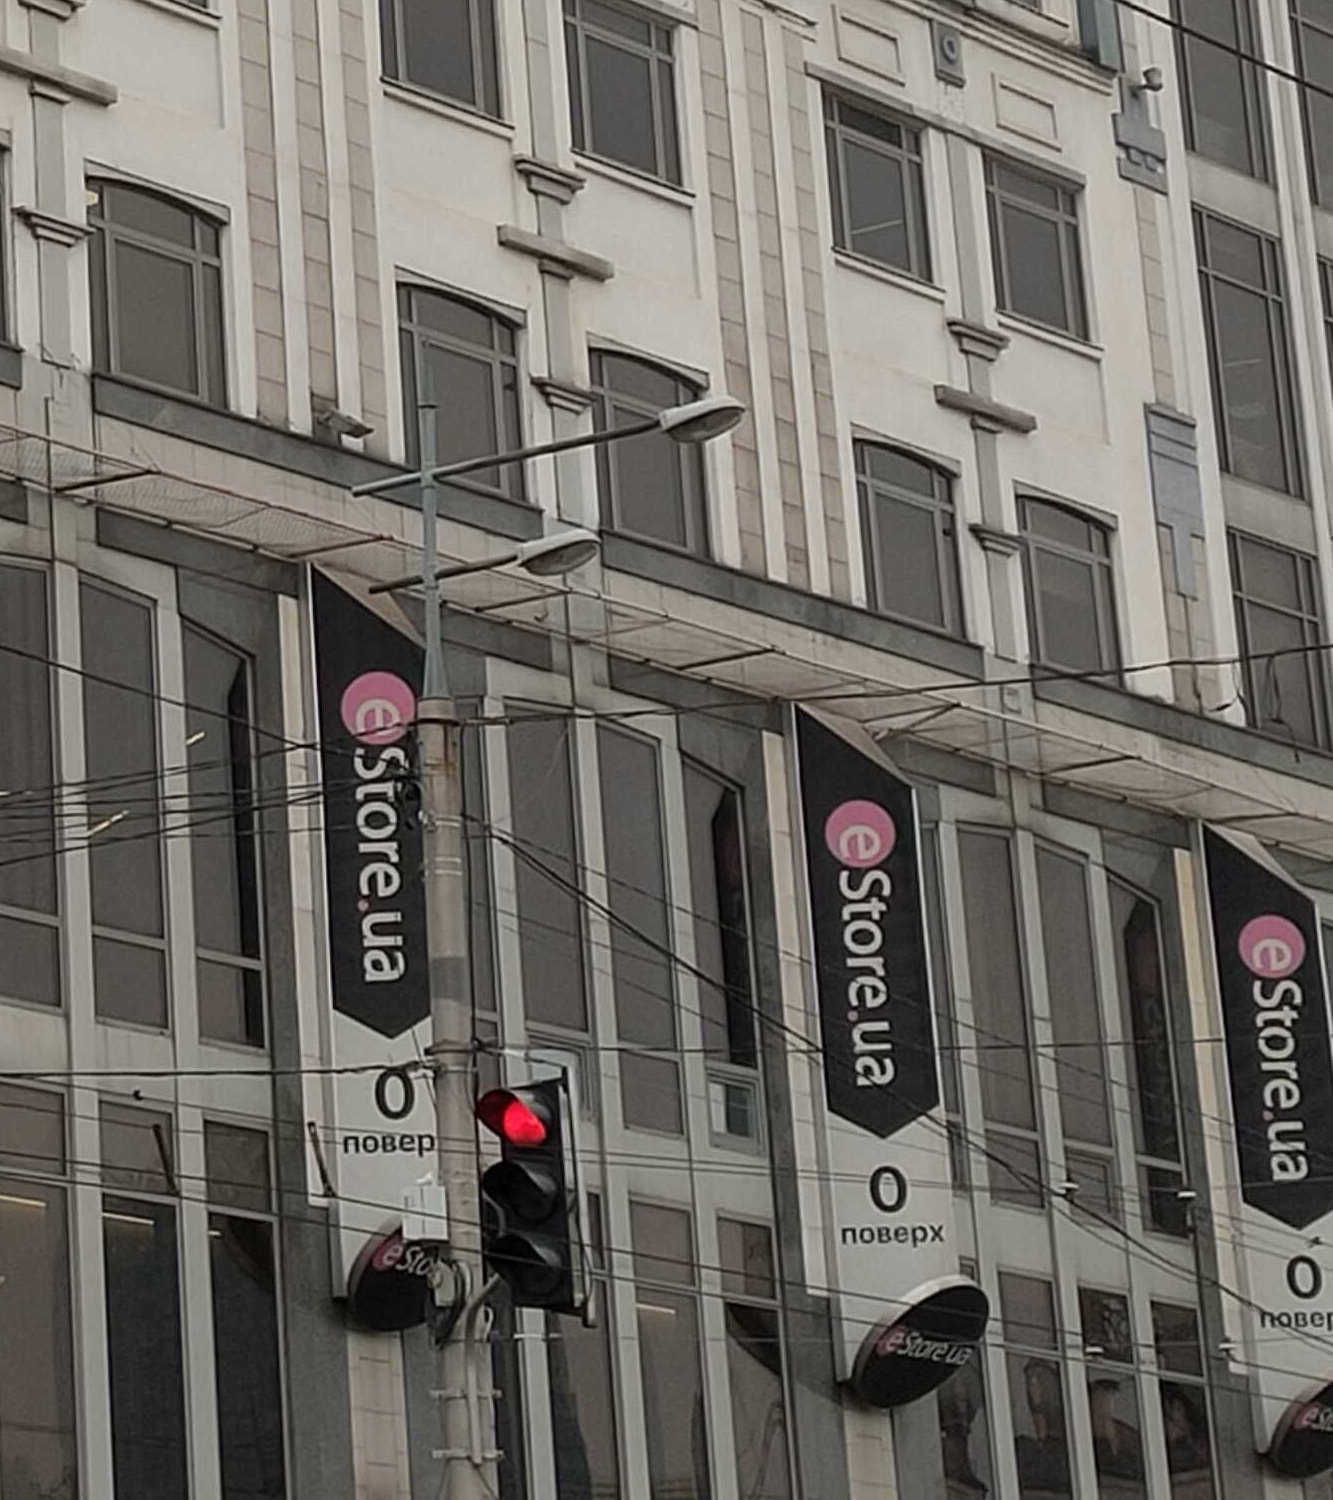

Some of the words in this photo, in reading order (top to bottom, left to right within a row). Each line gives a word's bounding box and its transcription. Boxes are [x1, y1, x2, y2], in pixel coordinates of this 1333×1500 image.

[353, 696, 409, 983] eStore.ua
[838, 825, 895, 1086] eStore.ua
[1252, 938, 1310, 1182] eStore.ua
[344, 1133, 436, 1157] повер
[841, 1224, 945, 1248] поверх
[886, 1332, 973, 1365] eStoreua
